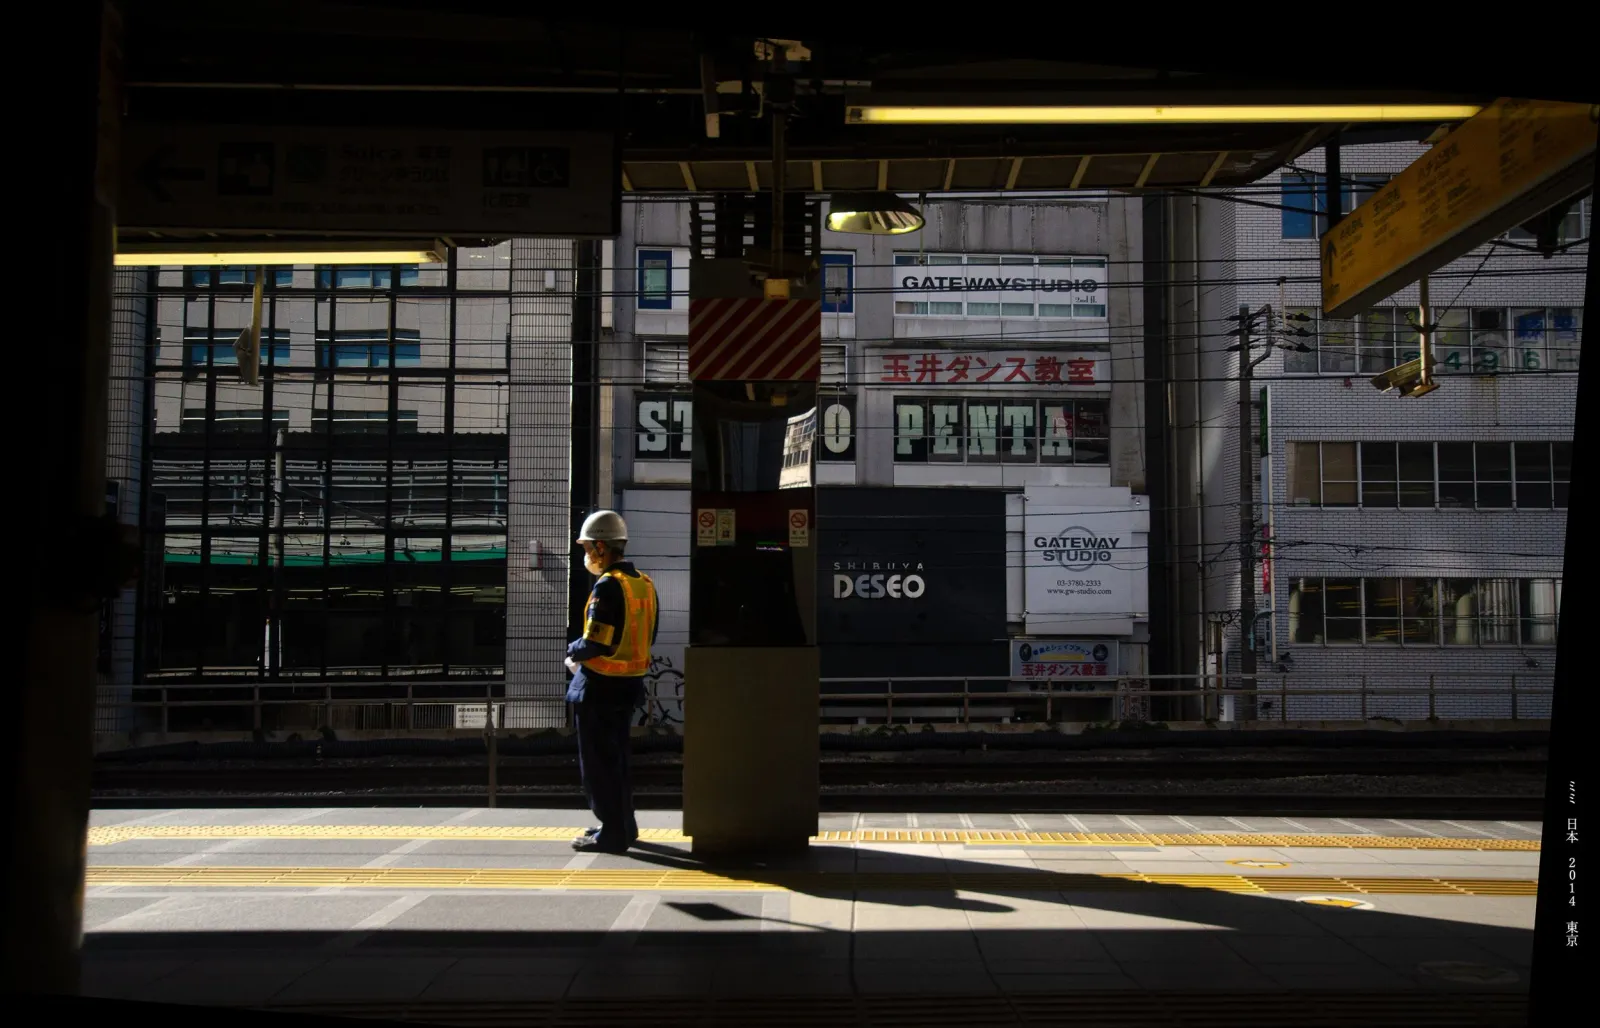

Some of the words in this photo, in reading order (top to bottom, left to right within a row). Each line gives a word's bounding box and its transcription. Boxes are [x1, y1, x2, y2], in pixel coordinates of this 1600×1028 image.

[881, 354, 1096, 386] 玉井ダンス教室
[895, 404, 1073, 456] PENTA
[1034, 536, 1120, 549] GATEWAY
[1043, 549, 1111, 562] STUDIO
[833, 562, 924, 571] SHIBUYA
[833, 574, 925, 598] DESEO
[1057, 580, 1102, 588] 03-3780-2333
[1047, 588, 1112, 597] www.gw-studio.com
[1021, 664, 1108, 676] 玉井ダンス教室
